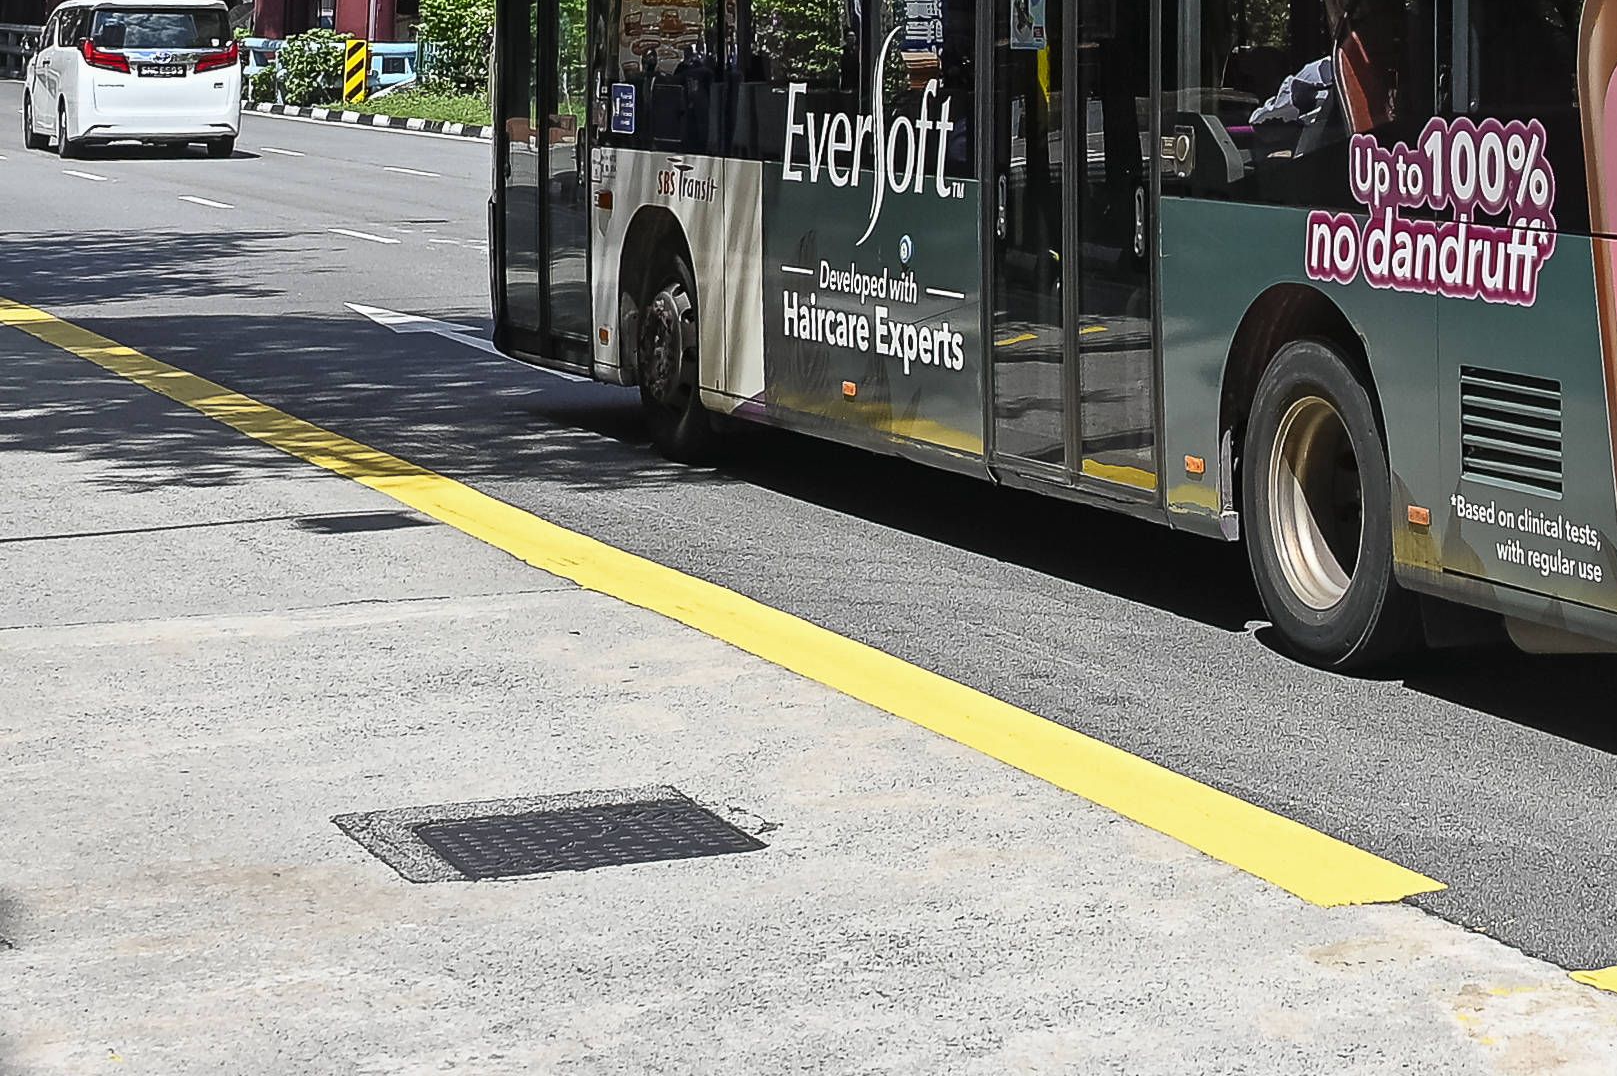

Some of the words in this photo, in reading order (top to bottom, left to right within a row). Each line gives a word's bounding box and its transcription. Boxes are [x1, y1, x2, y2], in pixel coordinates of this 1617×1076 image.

[657, 170, 676, 196] SBS
[673, 164, 718, 203] Transit
[1355, 147, 1390, 208] Up
[1396, 155, 1423, 195] to
[1423, 131, 1549, 207] 100%
[1311, 223, 1356, 272] no
[819, 260, 888, 304] Developed
[888, 271, 918, 304] with
[783, 290, 870, 352] Haircare
[875, 304, 965, 374] Experts
[1498, 510, 1515, 528] on
[1517, 507, 1562, 539] clinical
[1565, 520, 1601, 551] tests,
[1496, 539, 1525, 564] with
[1527, 549, 1575, 576] regular
[1578, 561, 1603, 582] use
